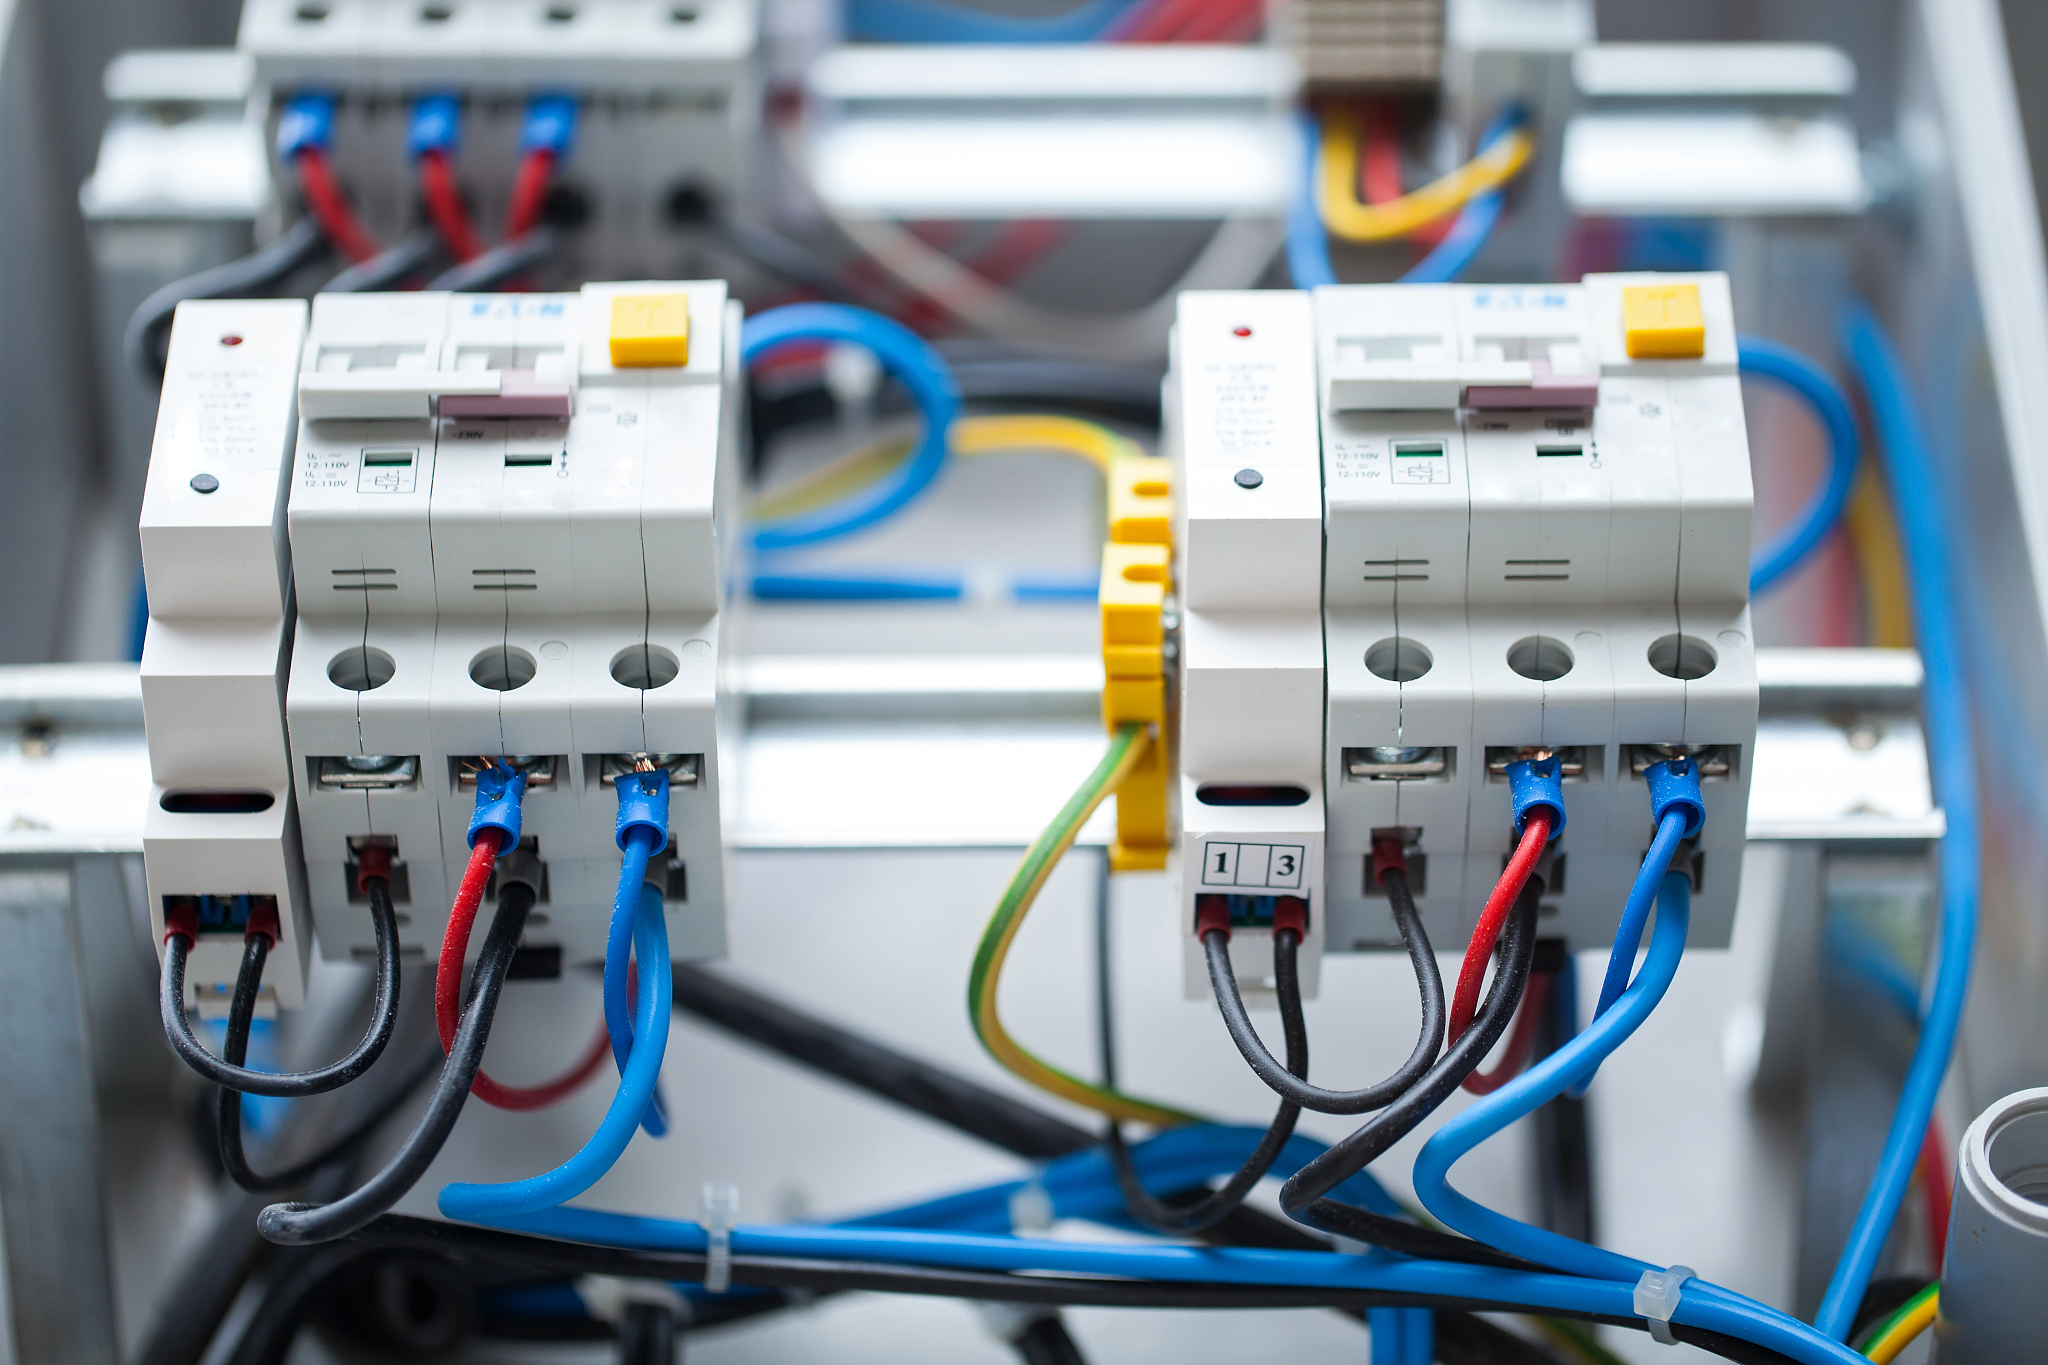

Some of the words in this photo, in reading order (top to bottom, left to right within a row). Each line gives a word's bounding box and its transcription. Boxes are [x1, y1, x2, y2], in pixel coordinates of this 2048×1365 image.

[1338, 470, 1381, 478] 12-110V
[305, 479, 348, 488] 12-110V
[1213, 852, 1228, 873] 1
[1276, 855, 1295, 876] 3
